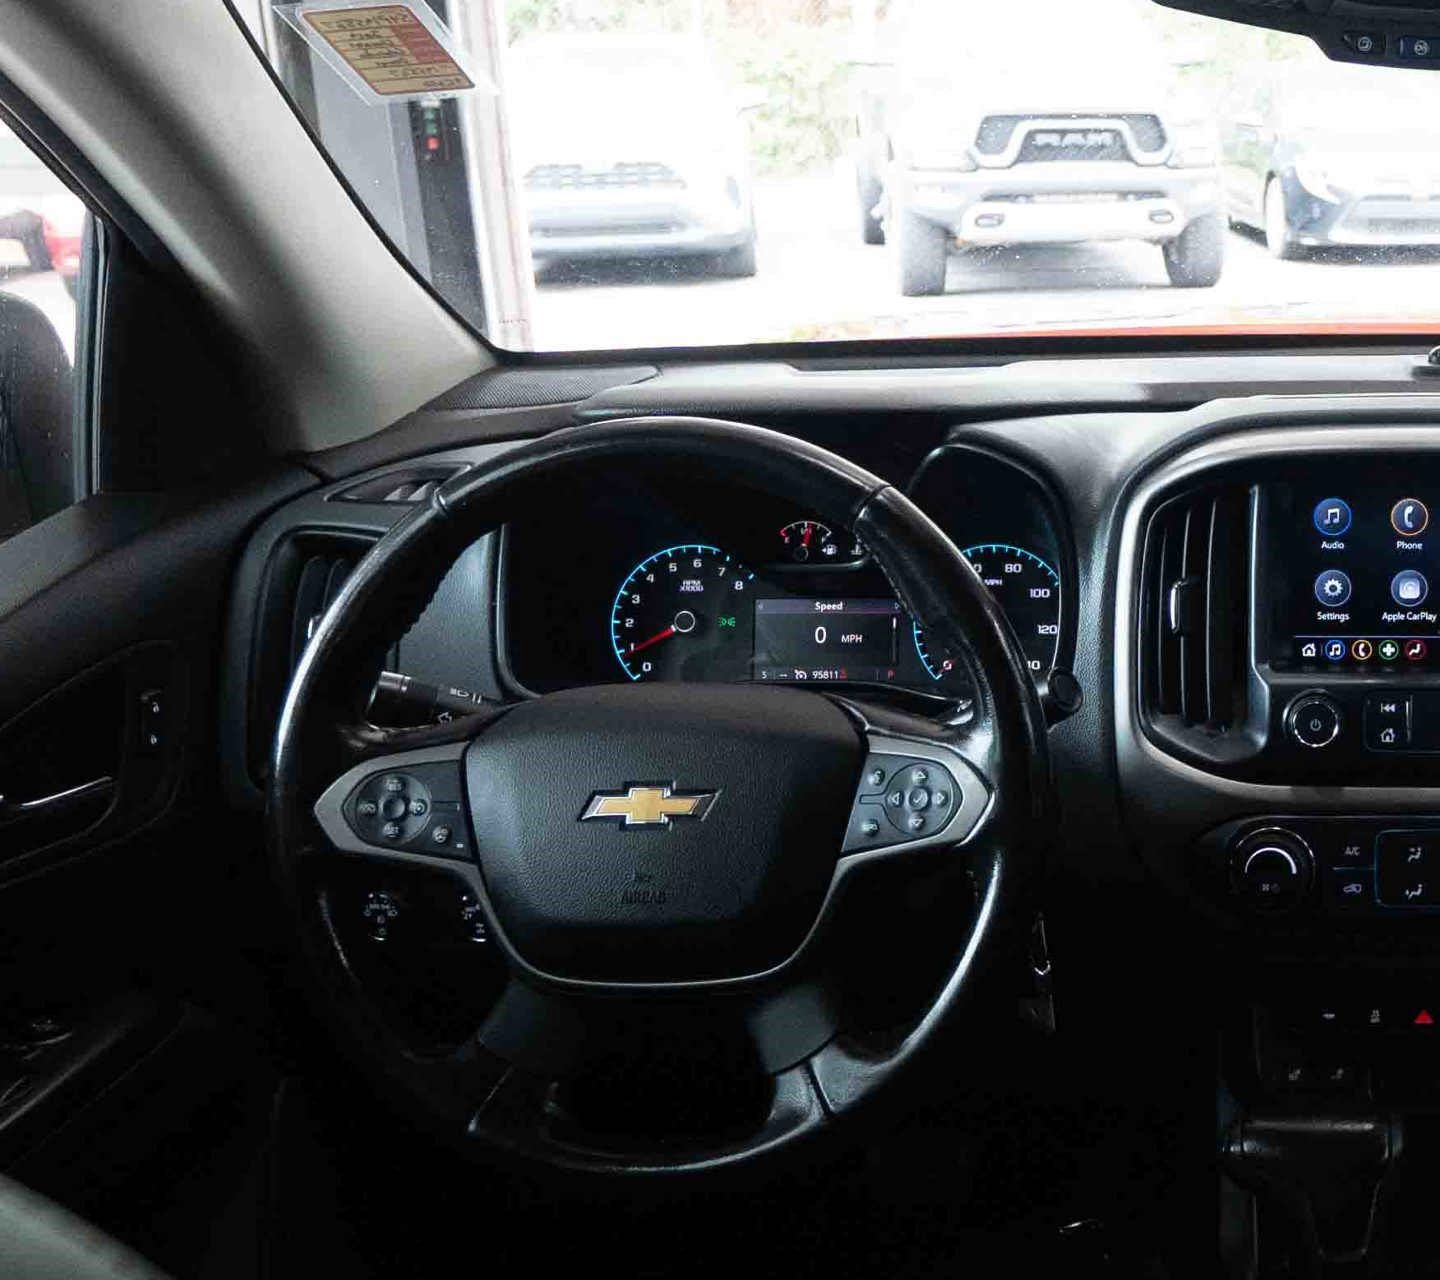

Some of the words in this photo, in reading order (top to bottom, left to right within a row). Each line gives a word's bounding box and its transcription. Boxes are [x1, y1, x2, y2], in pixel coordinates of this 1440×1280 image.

[1032, 132, 1115, 148] RAM
[1321, 540, 1345, 550] Audio
[1396, 540, 1423, 550] Phone
[668, 562, 678, 573] 5
[692, 558, 702, 568] 6
[718, 567, 727, 577] 7
[646, 573, 655, 584] 4
[734, 581, 744, 591] 8
[631, 594, 641, 604] 3
[1030, 588, 1050, 599] 100
[814, 601, 843, 613] Speed
[1317, 611, 1351, 623] Settings
[1382, 611, 1405, 622] Apple
[1406, 611, 1438, 623] CarPlay
[625, 618, 635, 628] 2
[814, 626, 827, 644] 0
[841, 634, 863, 643] MPH
[1037, 624, 1058, 635] 120
[642, 661, 652, 672] 0
[811, 670, 839, 680] 95811
[1343, 845, 1361, 857] A/C
